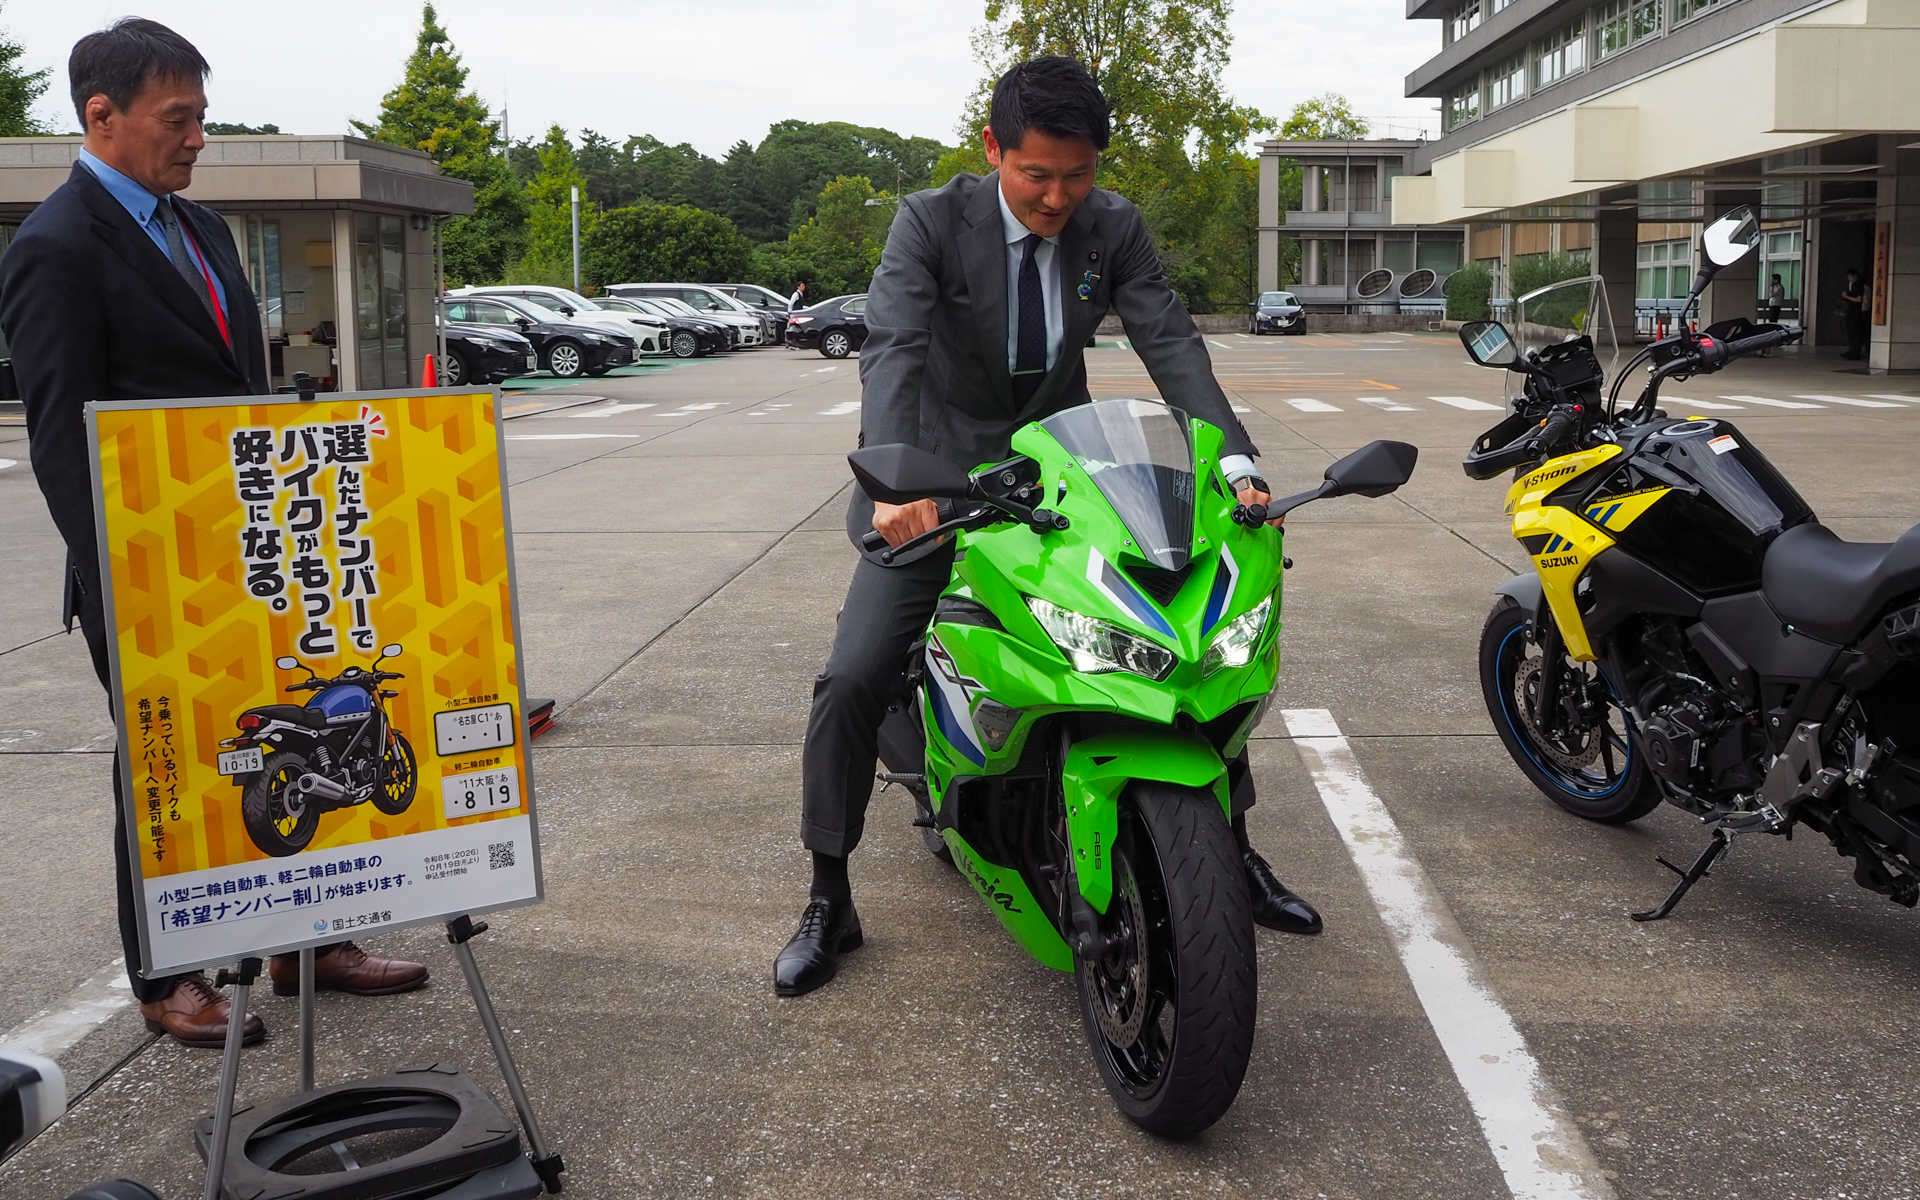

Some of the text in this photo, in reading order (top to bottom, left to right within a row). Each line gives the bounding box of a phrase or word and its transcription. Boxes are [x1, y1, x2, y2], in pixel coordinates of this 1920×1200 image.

[1523, 464, 1578, 490] V-Strom
[233, 430, 287, 612] 好きになる。
[280, 426, 335, 655] バイクがもっと
[323, 424, 377, 650] 選んだナンバーで
[1540, 555, 1579, 569] SUZUKI
[445, 693, 499, 707] 小型二輪自動車
[157, 695, 181, 822] 今乗っているバイクも
[225, 758, 258, 772] 10-19
[454, 757, 501, 771] 軽二輪自動車
[138, 697, 166, 862] 希望ナンバーへ変更可能です
[1094, 831, 1102, 870] ABS
[158, 855, 382, 906] 小型二輪自動車、軽二輪自動車の
[425, 867, 468, 881] 申込受付開始
[954, 846, 1023, 914] Ninja
[332, 910, 392, 931] 国土交通省
